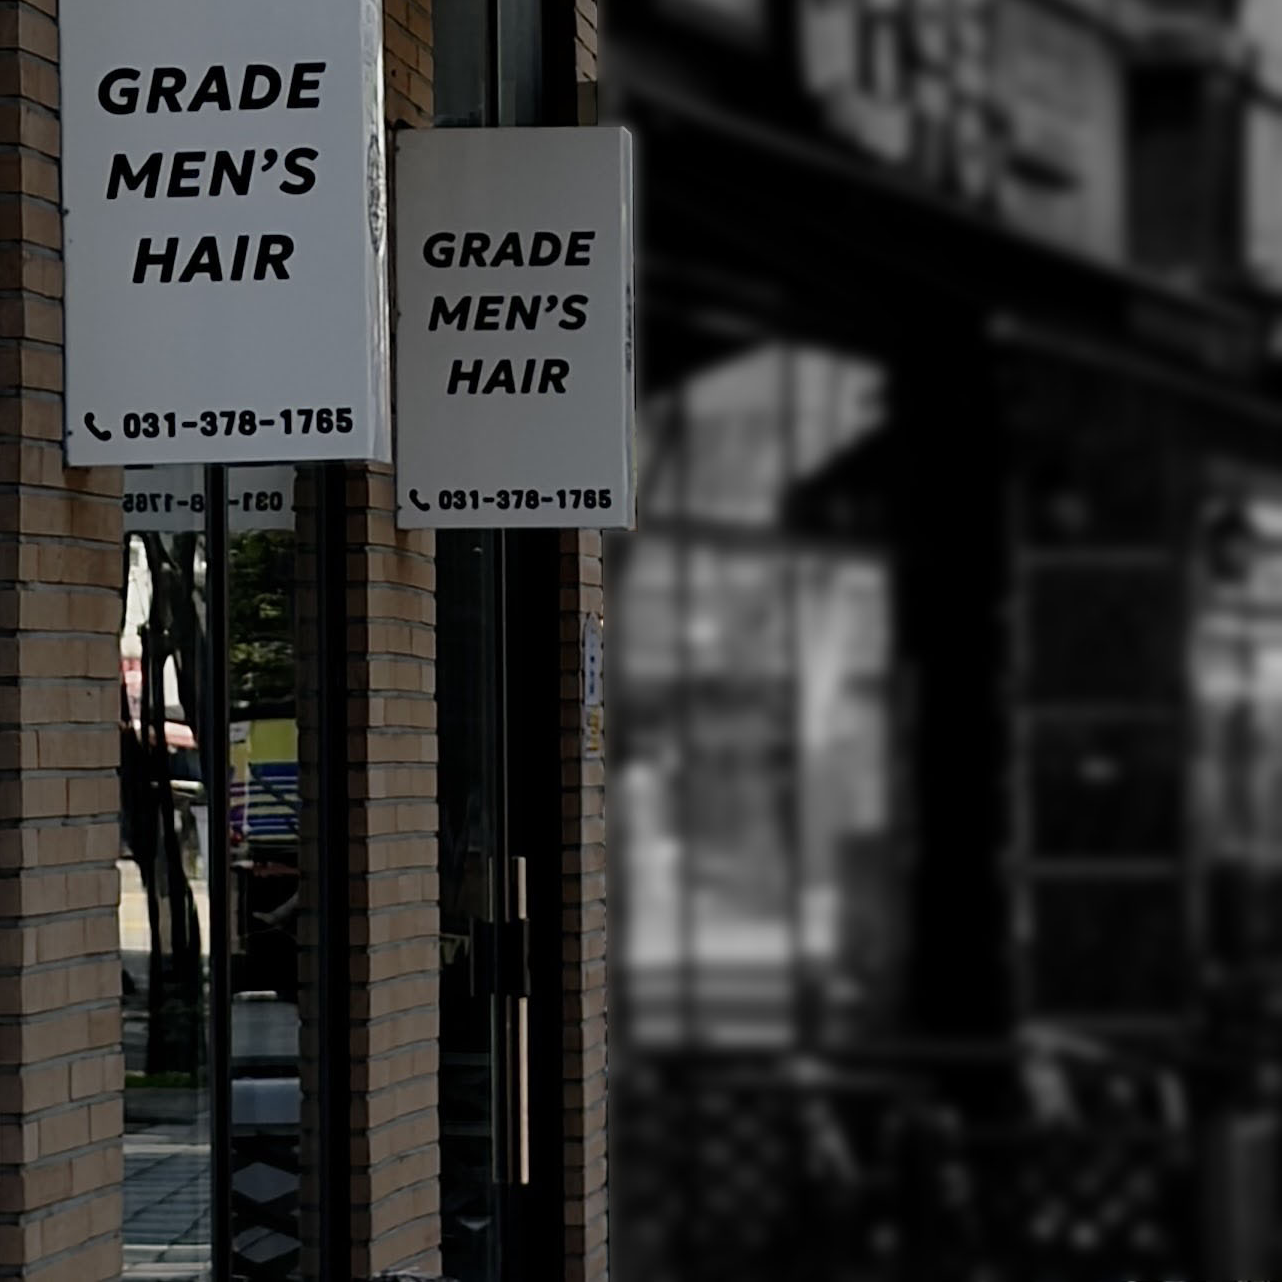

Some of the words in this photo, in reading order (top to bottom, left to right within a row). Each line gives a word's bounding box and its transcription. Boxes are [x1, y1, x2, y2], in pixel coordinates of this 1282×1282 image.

[97, 61, 327, 116] GRADE
[106, 147, 319, 200] MEN'S
[132, 234, 295, 284] HAIR
[422, 230, 596, 269] GRADE
[427, 294, 589, 332] MEN'S
[446, 358, 570, 395] HAIR
[123, 407, 353, 439] 031-378-1765
[438, 488, 612, 511] 031-378-1765
